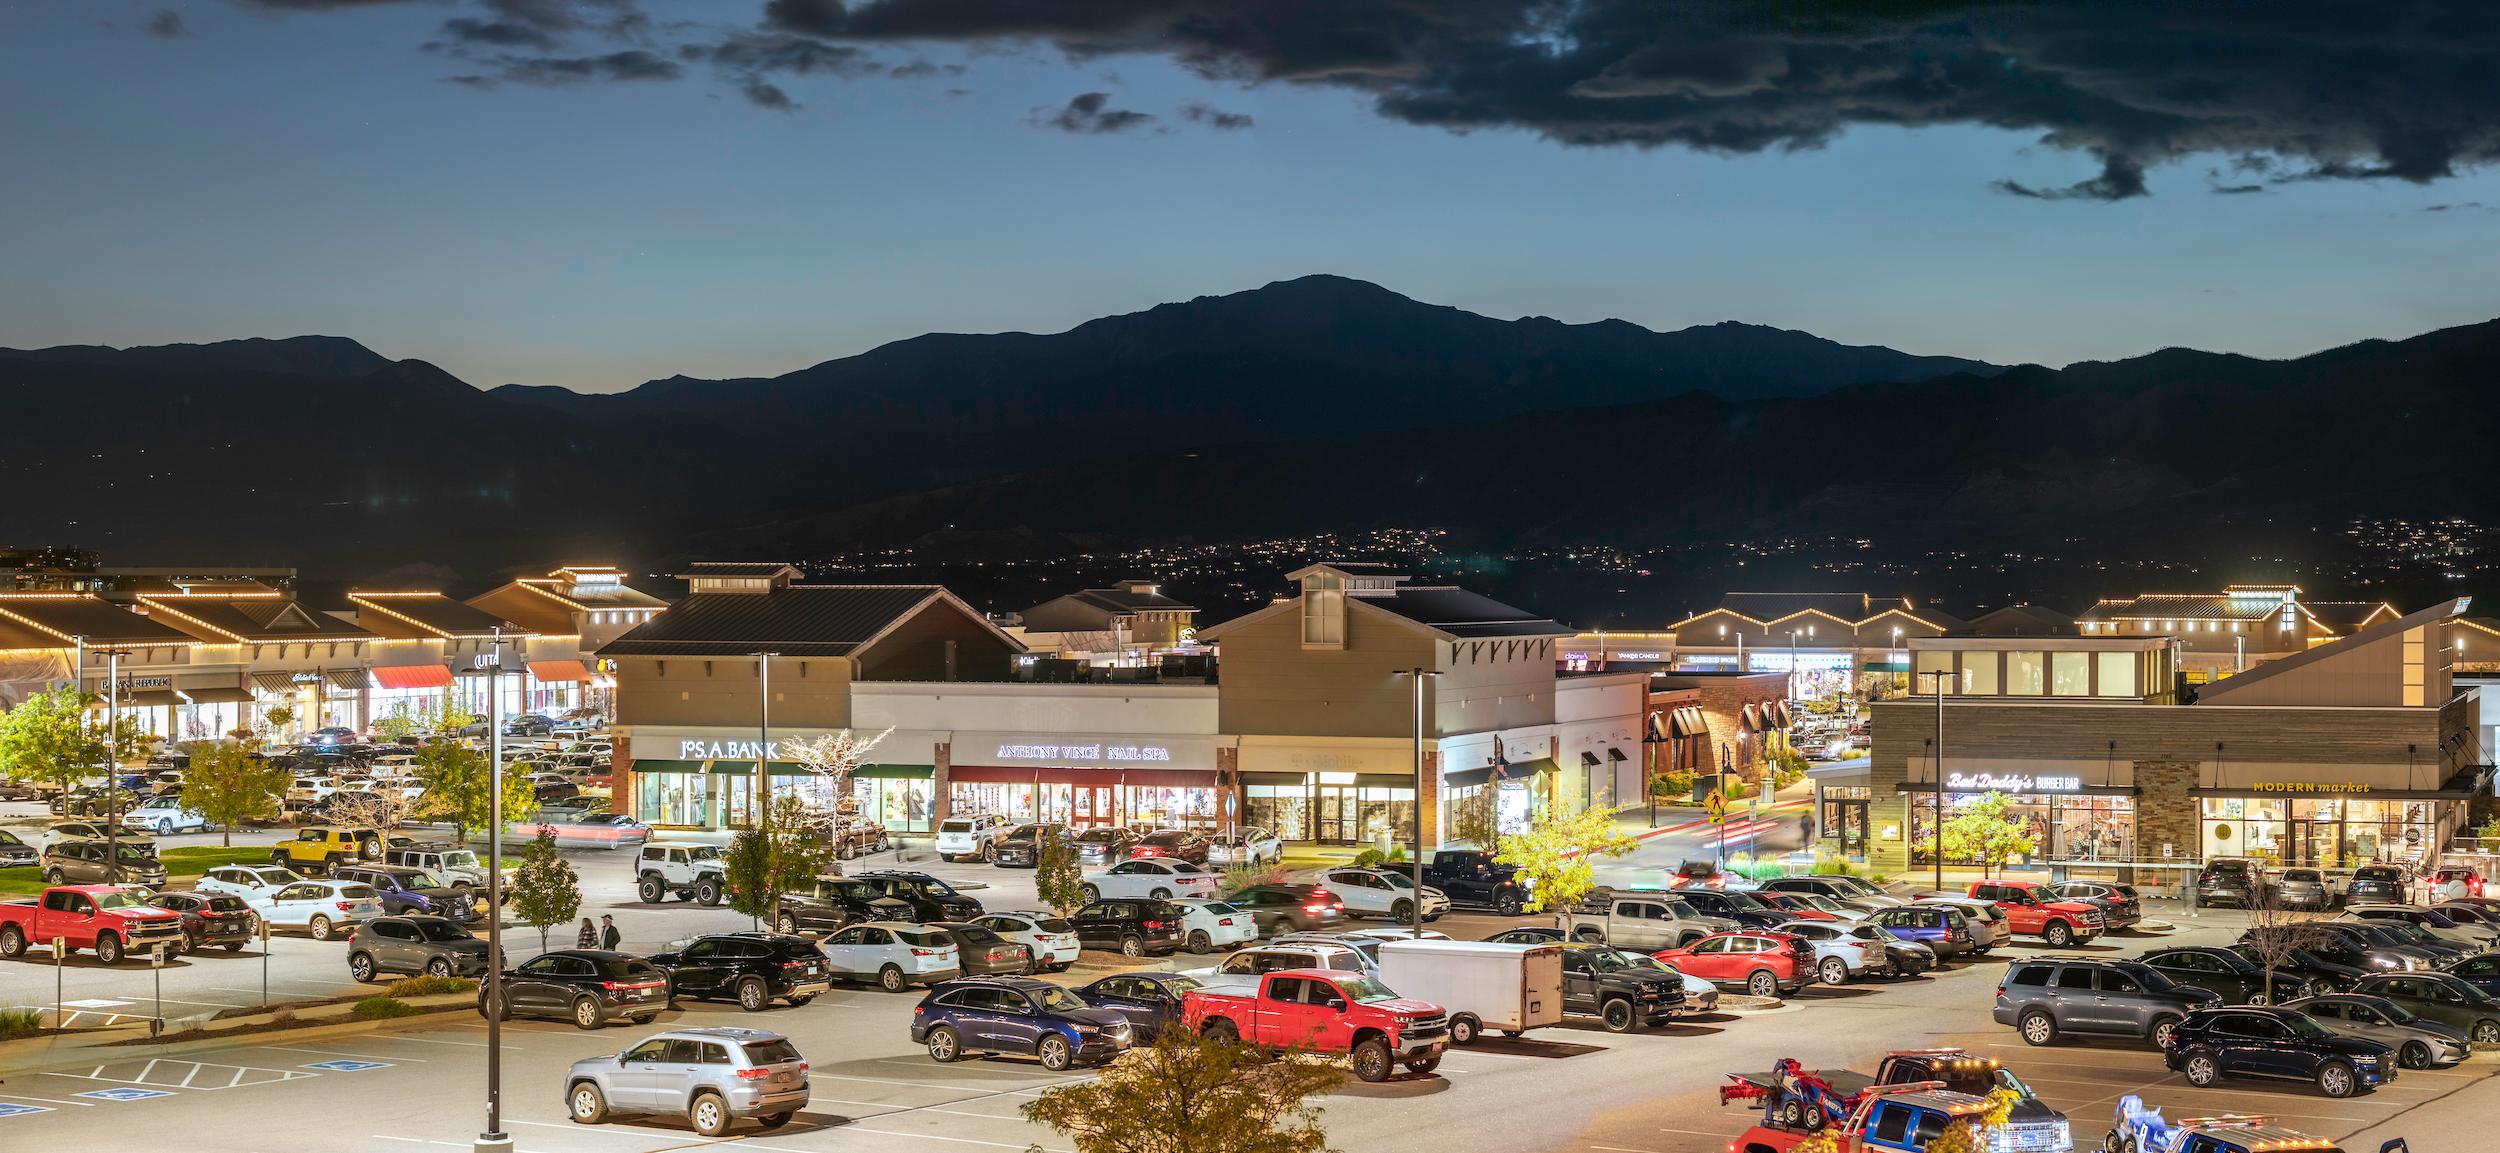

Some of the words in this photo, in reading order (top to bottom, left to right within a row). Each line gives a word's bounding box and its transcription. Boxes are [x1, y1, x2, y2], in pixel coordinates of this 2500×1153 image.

[997, 745, 1059, 759] ANTHONY
[1107, 747, 1141, 760] NAIL
[1143, 747, 1169, 761] SPA
[1947, 772, 1978, 788] Bad
[1976, 773, 2034, 792] Daddy's
[2036, 776, 2064, 790] BURGER
[2064, 776, 2079, 790] BAR
[2253, 782, 2315, 792] MODERN
[2318, 781, 2370, 793] market
